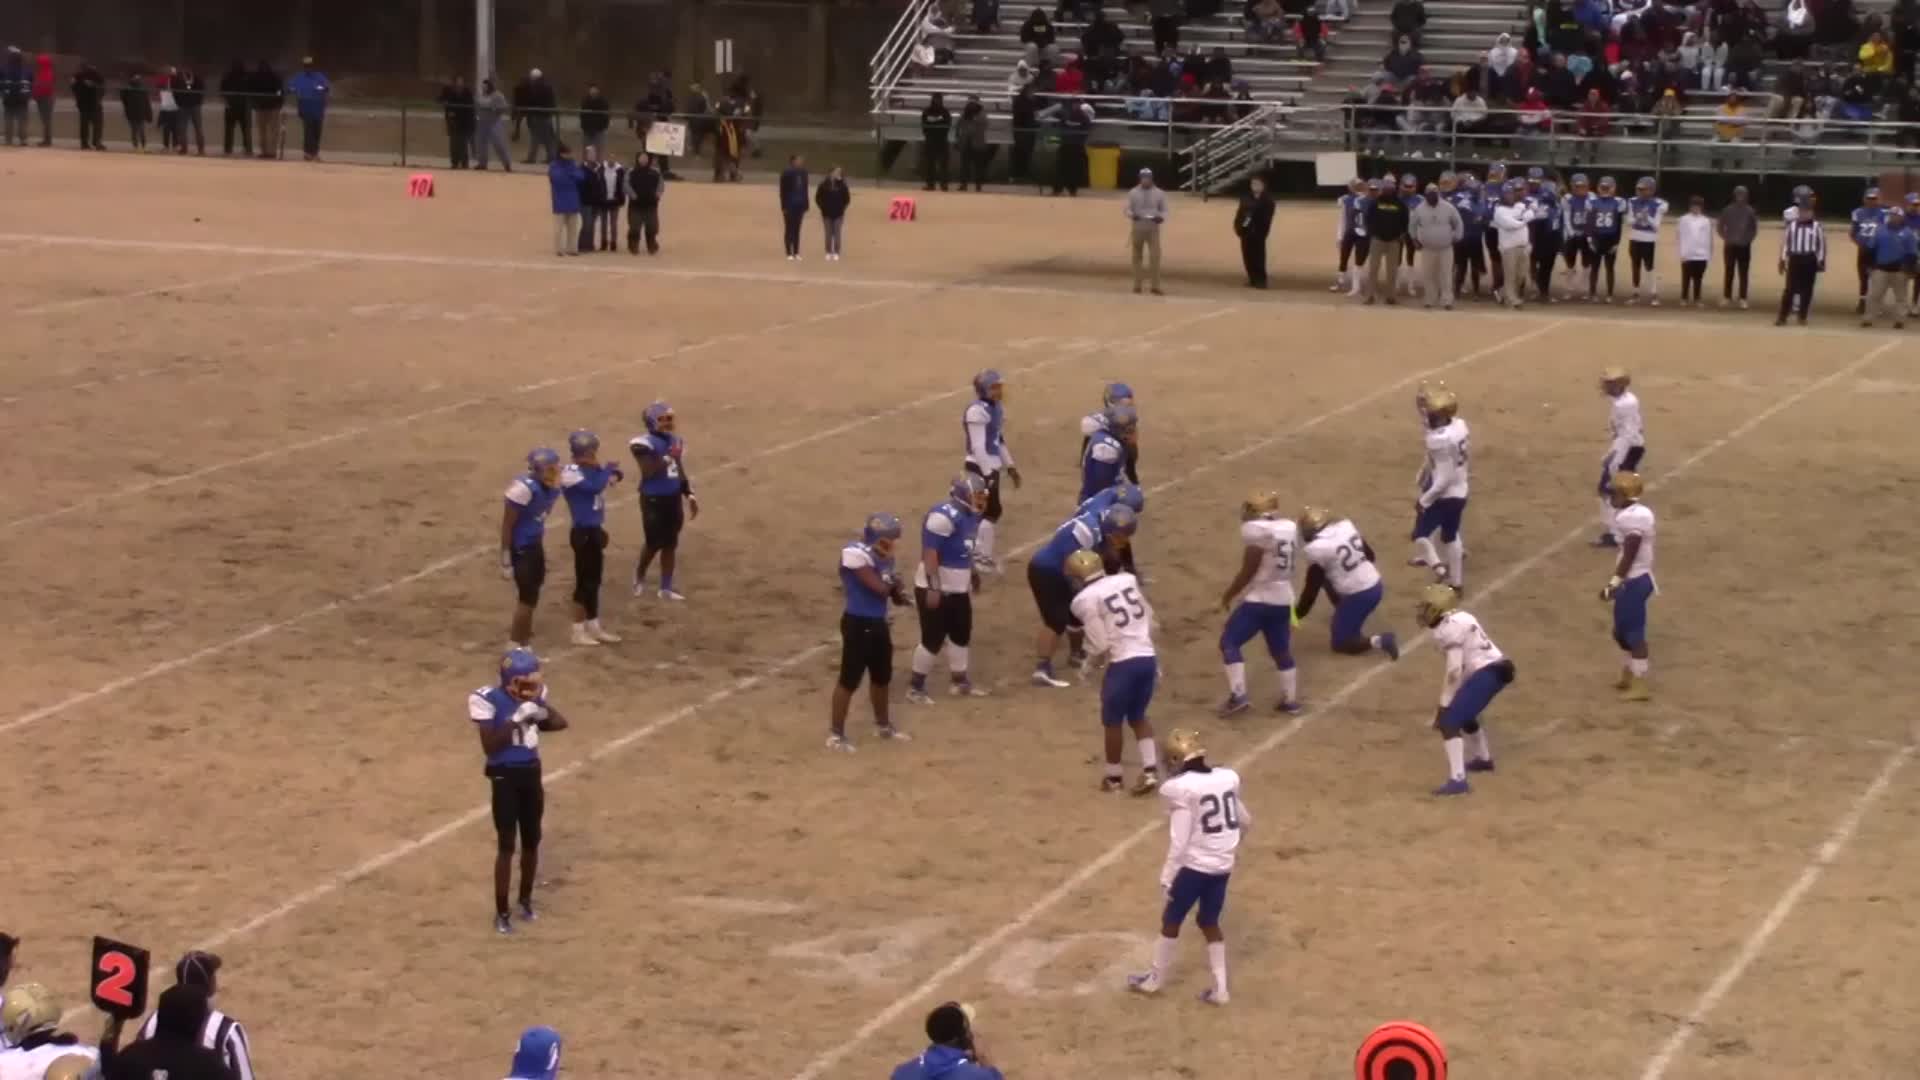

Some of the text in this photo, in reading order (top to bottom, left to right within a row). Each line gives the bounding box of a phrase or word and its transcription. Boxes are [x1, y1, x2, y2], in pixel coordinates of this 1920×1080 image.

[889, 200, 912, 220] 20
[1104, 587, 1145, 628] 55
[1199, 790, 1240, 833] 20
[95, 950, 136, 1006] 2
